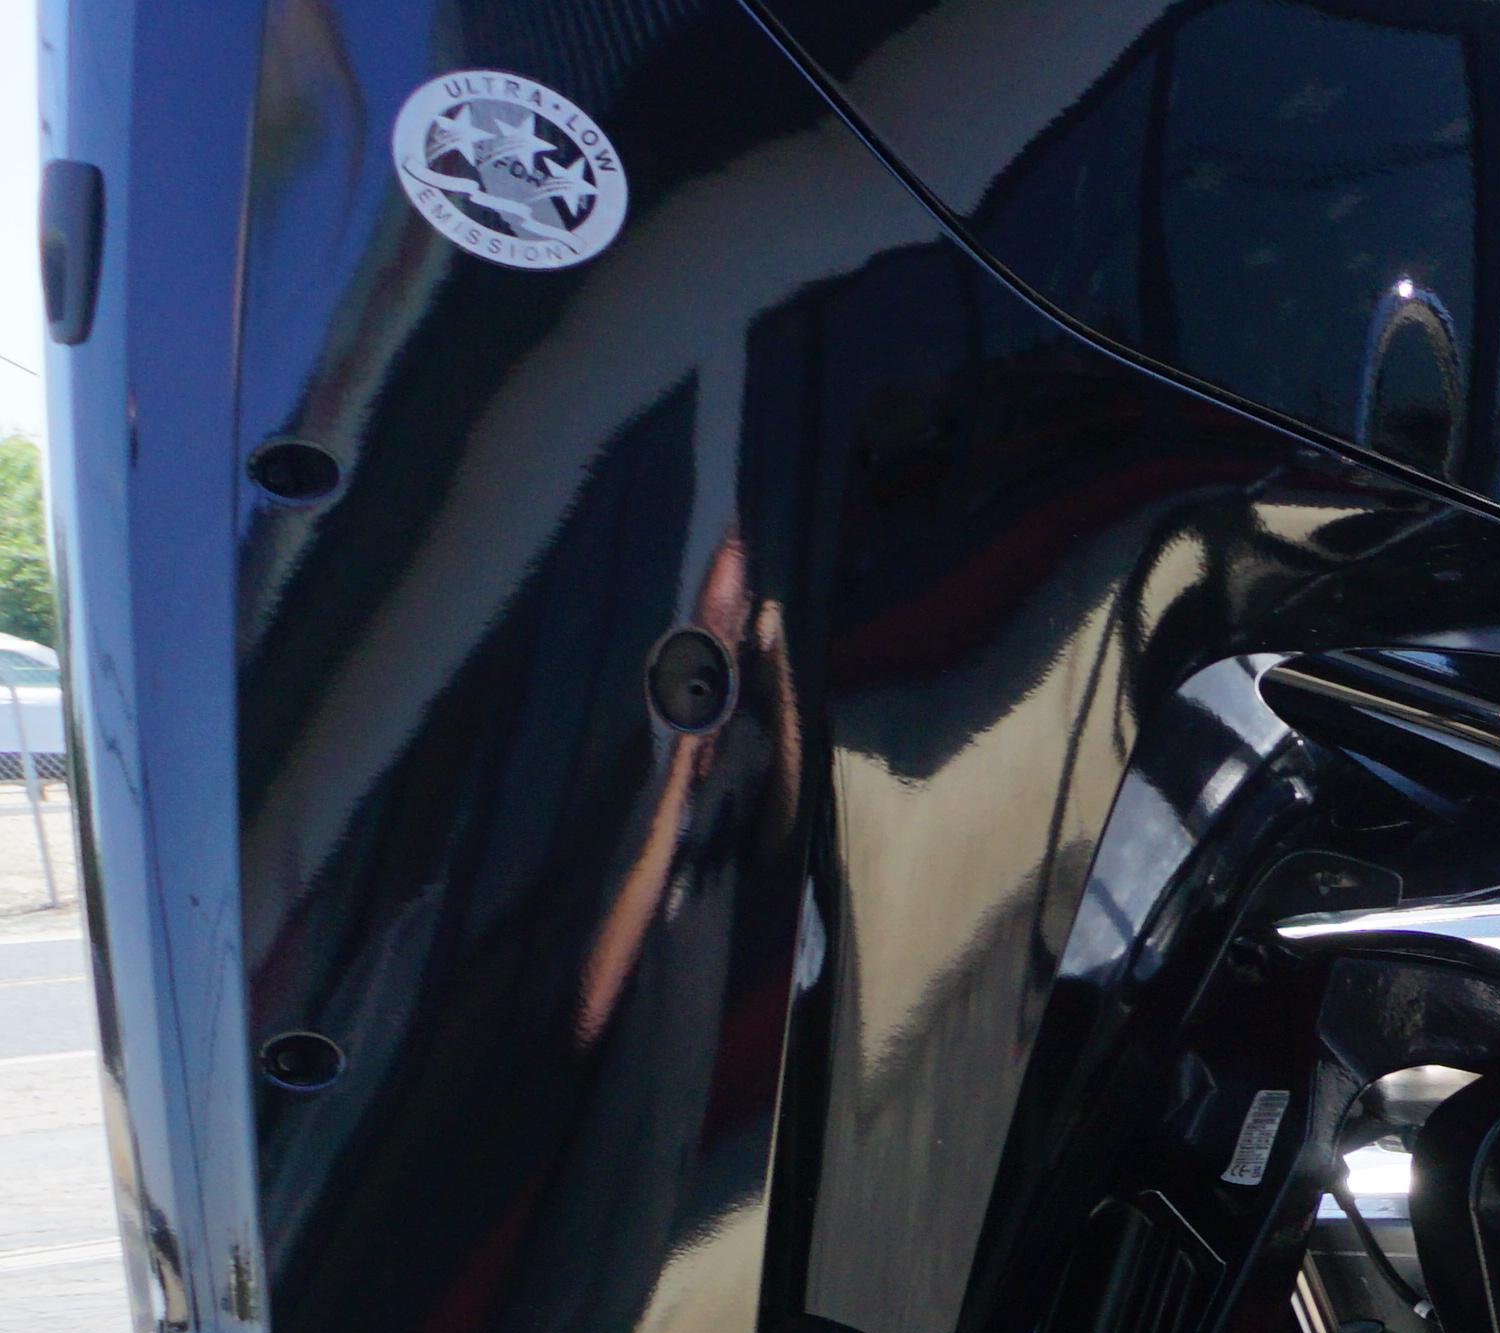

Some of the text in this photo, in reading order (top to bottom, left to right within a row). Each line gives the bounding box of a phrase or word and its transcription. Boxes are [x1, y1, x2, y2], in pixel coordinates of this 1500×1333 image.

[443, 76, 619, 175] ULTRA LOW
[415, 187, 564, 262] EMISSION
